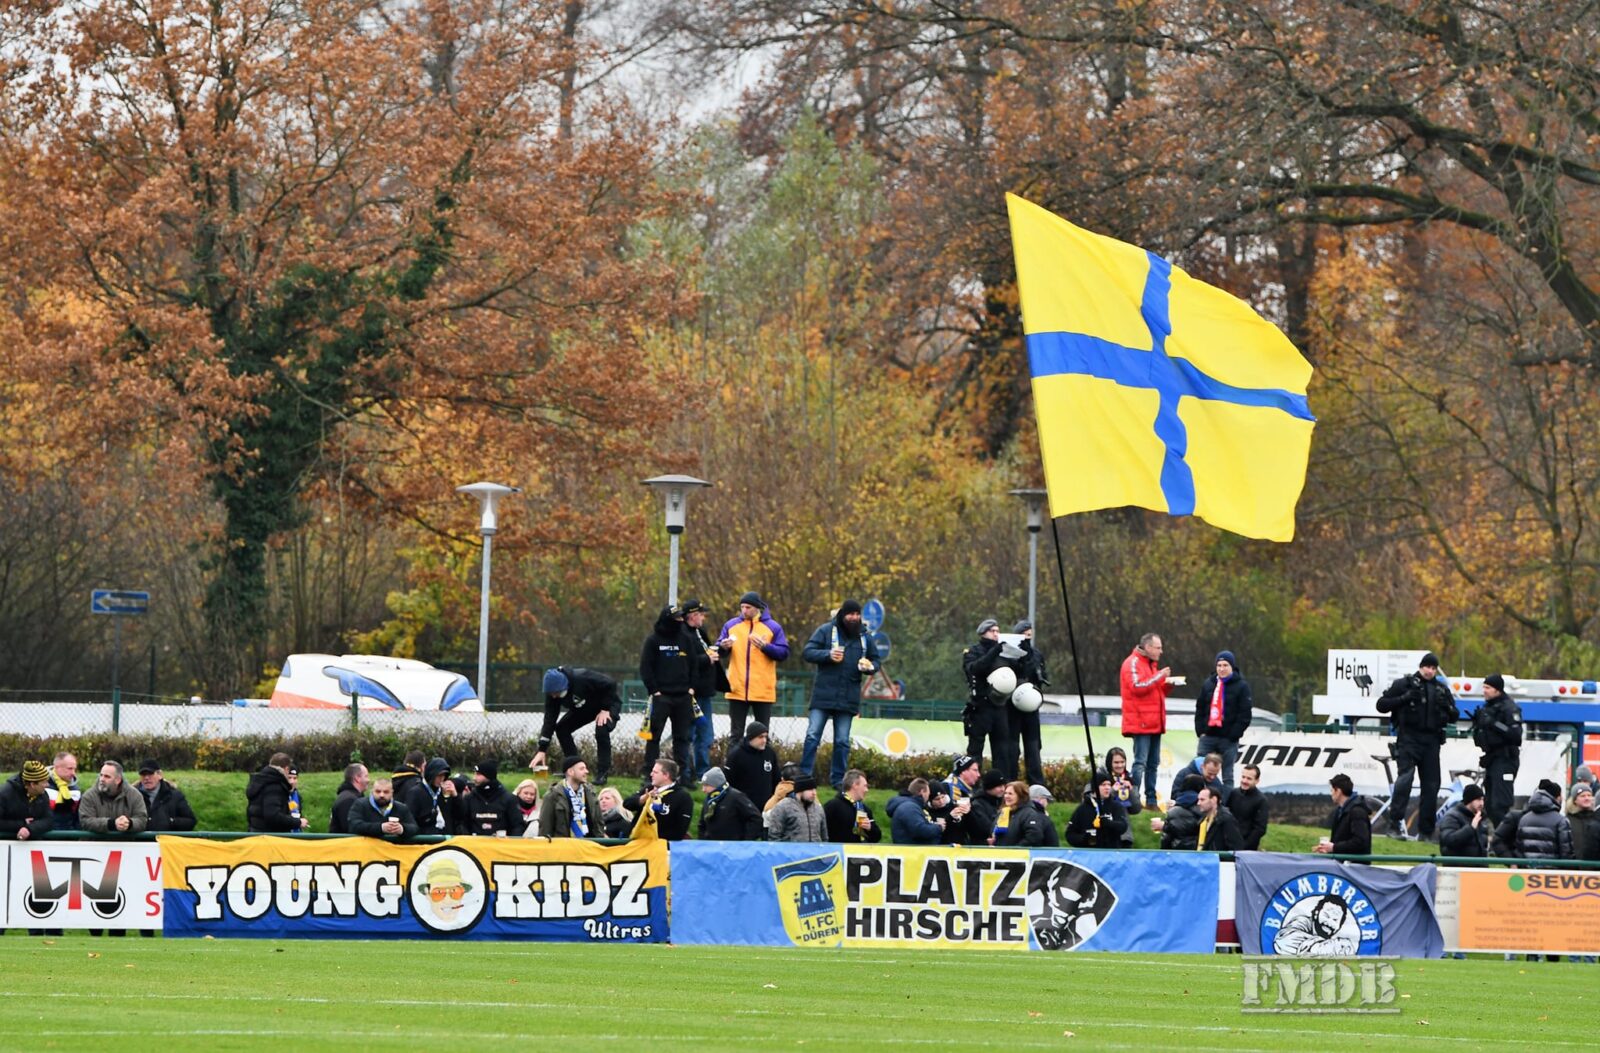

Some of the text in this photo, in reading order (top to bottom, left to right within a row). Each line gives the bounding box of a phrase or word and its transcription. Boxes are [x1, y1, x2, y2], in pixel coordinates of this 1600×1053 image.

[1335, 657, 1368, 680] Heim
[186, 861, 404, 921] YOUNG
[491, 860, 649, 920] KIDZ
[846, 857, 1026, 906] PLATZ
[804, 914, 834, 931] 1. FC
[846, 907, 1024, 941] HIRSCHE
[1264, 875, 1378, 940] BAUMBERGER
[584, 918, 651, 938] Ultras
